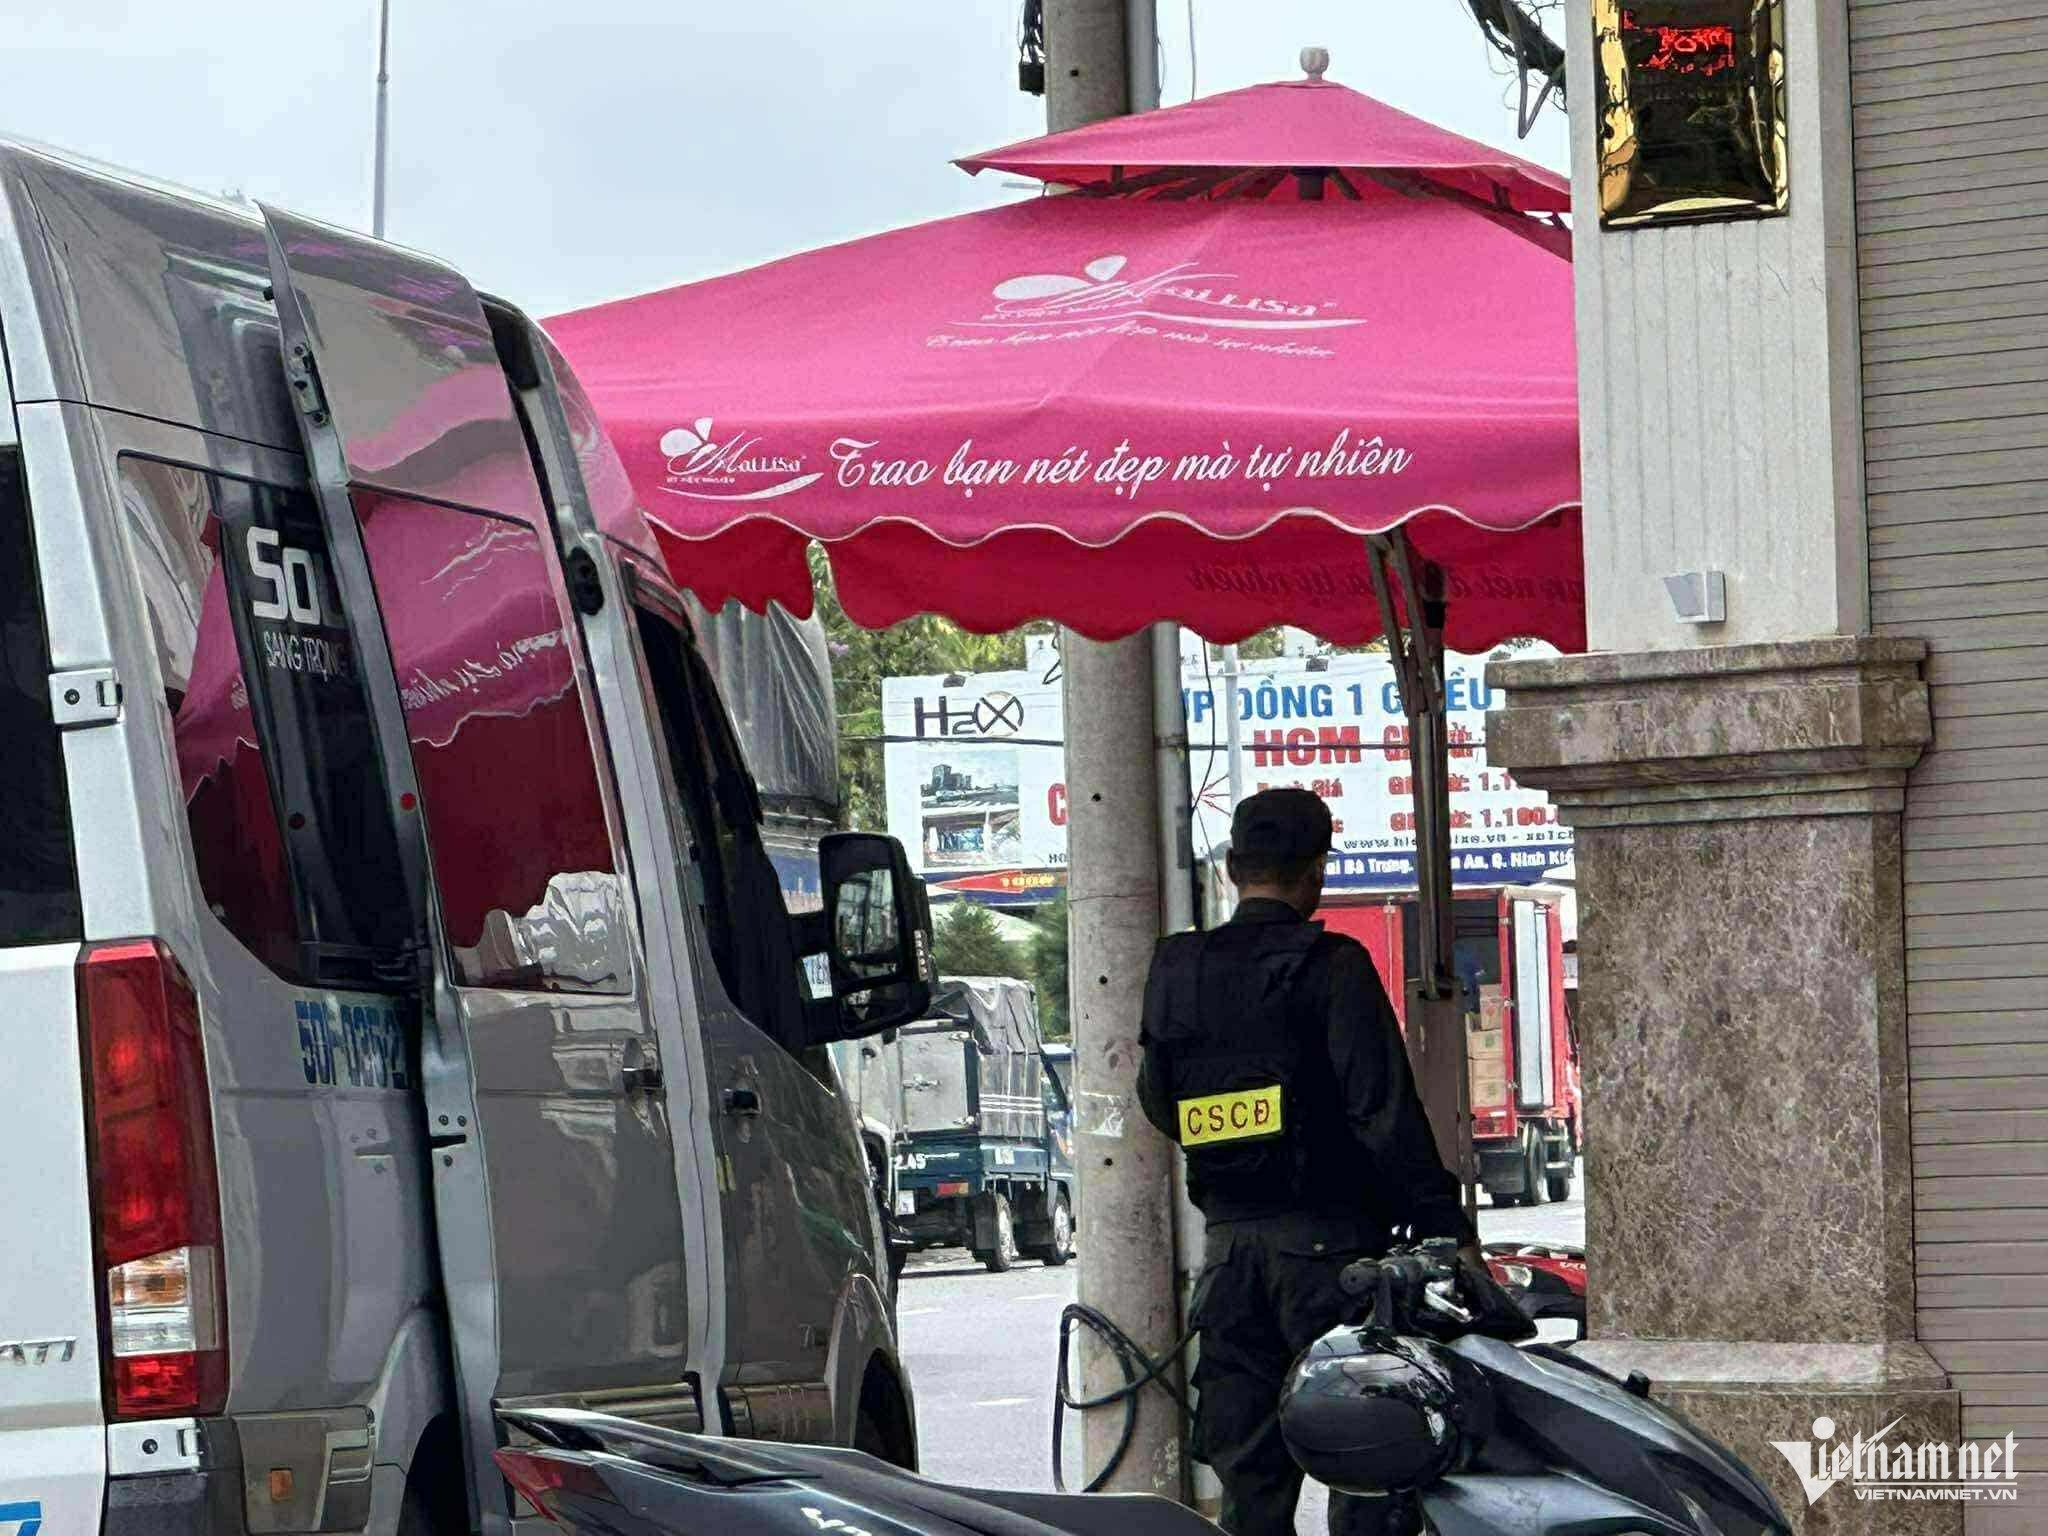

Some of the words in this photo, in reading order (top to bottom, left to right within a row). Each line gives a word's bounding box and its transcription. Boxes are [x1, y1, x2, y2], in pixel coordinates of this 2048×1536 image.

[830, 438, 937, 487] Trao
[944, 439, 1020, 498] bạn
[1023, 447, 1092, 485] nét
[1094, 438, 1170, 499] đẹp
[1172, 440, 1240, 482] mà
[1245, 444, 1293, 492] tự
[1296, 428, 1413, 477] nhiên
[1347, 683, 1363, 716] 1
[1187, 1098, 1270, 1136] CSCĐ
